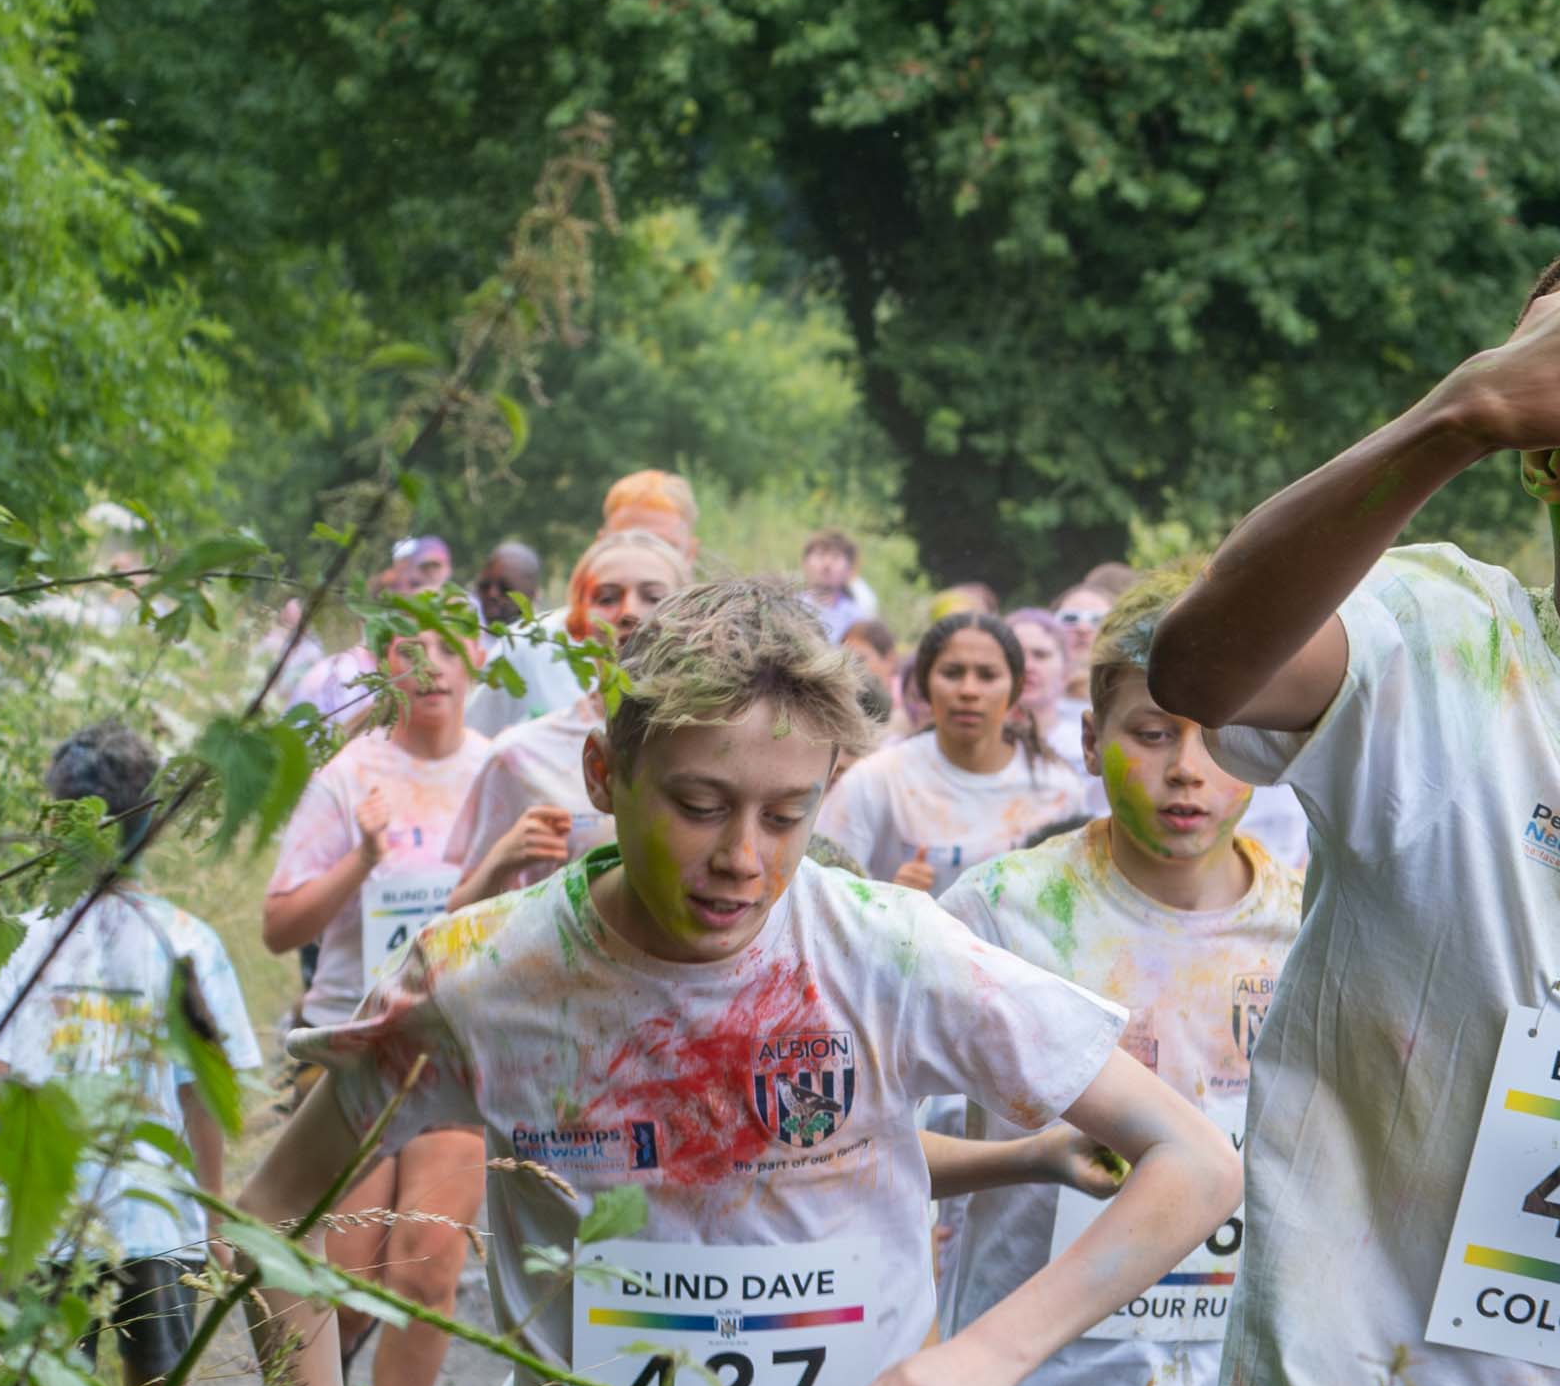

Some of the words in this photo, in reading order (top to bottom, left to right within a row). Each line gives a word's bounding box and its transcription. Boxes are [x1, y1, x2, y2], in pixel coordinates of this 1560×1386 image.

[759, 1037, 849, 1061] ALBION
[513, 1127, 620, 1143] Pertemps
[757, 1161, 788, 1174] part
[791, 1156, 809, 1168] of
[810, 1153, 834, 1165] our
[622, 1272, 728, 1300] BLIND
[742, 1270, 835, 1300] DAVE
